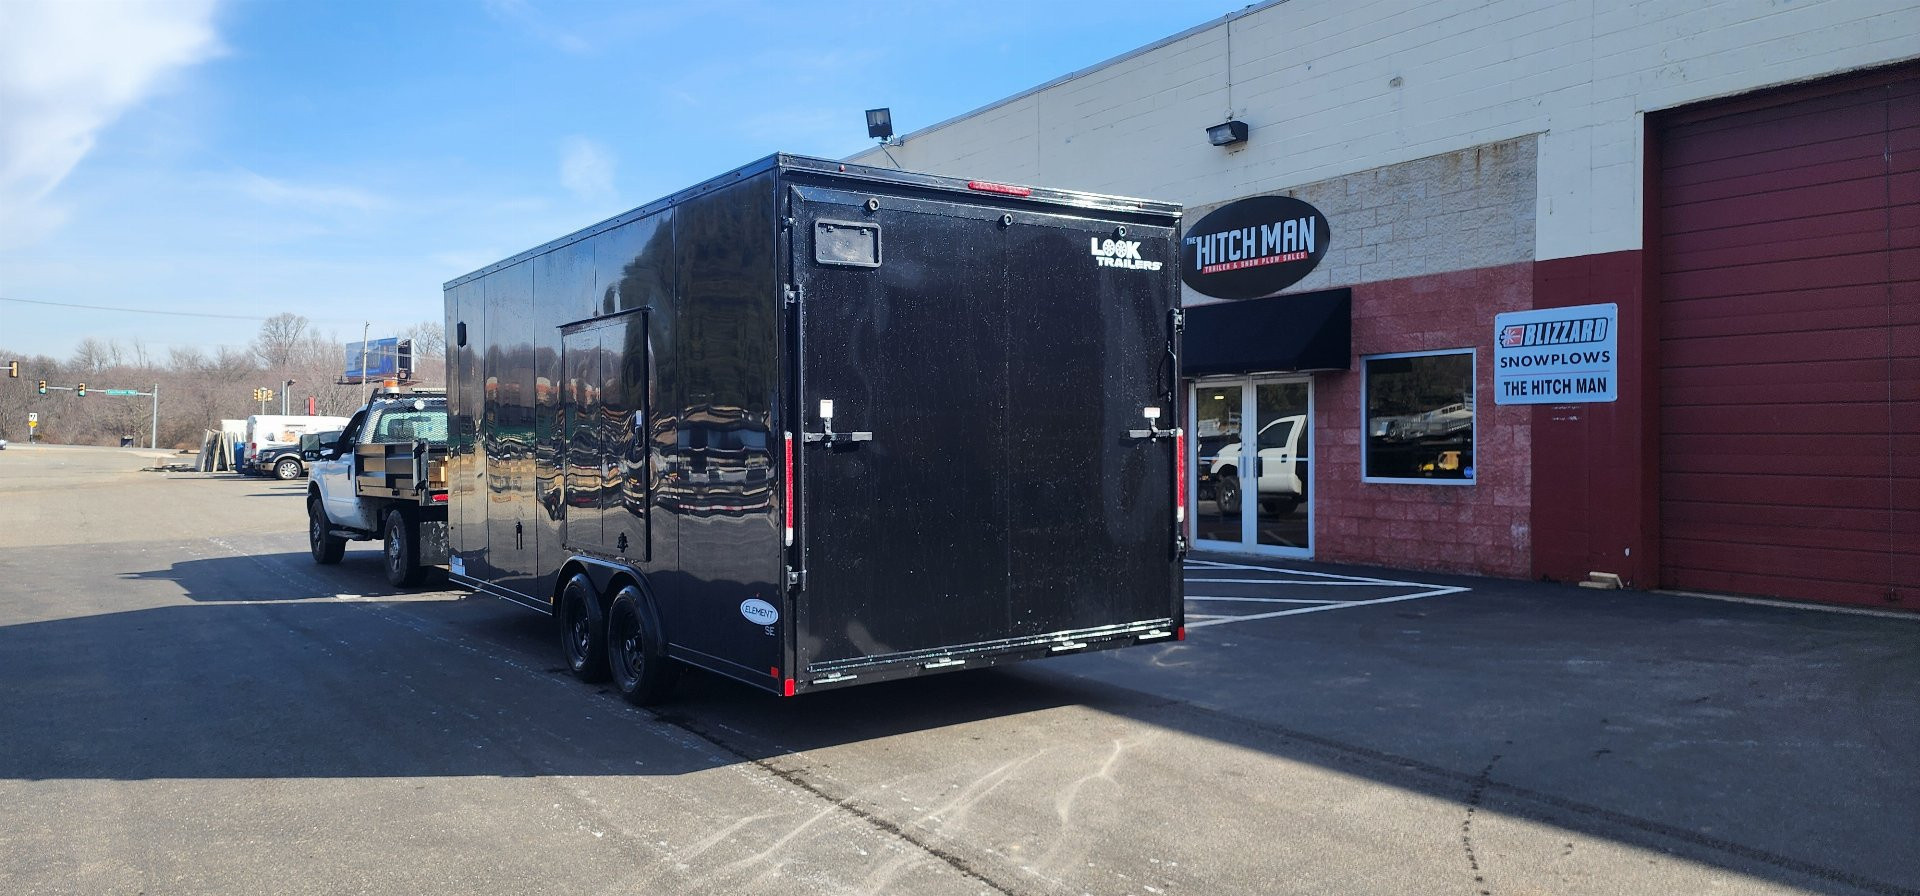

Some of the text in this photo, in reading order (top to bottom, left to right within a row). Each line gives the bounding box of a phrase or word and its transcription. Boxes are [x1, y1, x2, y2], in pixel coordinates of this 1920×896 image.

[1091, 237, 1141, 259] LOOK
[1186, 215, 1315, 270] THE HITCH MAN
[1096, 256, 1162, 271] TRAILERS
[1204, 262, 1231, 274] TRAILER
[1240, 259, 1259, 268] SNOW
[1261, 255, 1281, 265] PLOW
[1283, 252, 1305, 262] SALES
[1523, 318, 1608, 346] BLIZZARD
[1500, 351, 1610, 368] SNOWPLOWS
[1504, 377, 1607, 396] THE HITCH MAN
[745, 605, 773, 619] ELEMENT
[765, 626, 775, 636] SE
